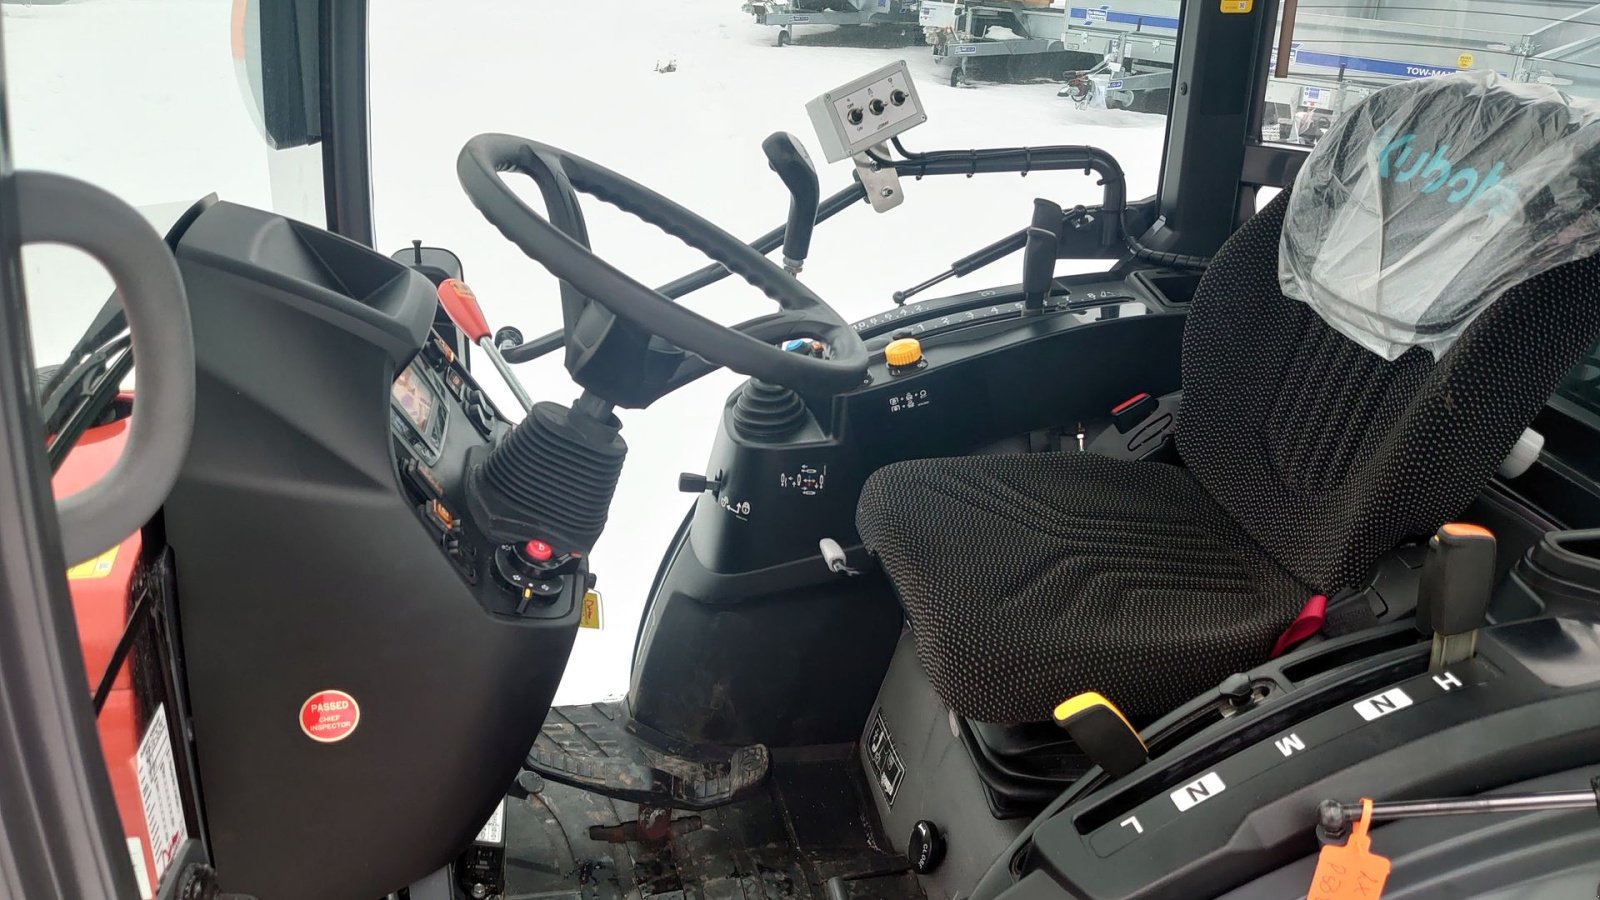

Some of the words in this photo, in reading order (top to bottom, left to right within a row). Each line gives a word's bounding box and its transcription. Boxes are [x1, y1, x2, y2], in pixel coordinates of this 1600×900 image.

[1431, 671, 1464, 691] H
[311, 701, 349, 712] PASSED
[1369, 694, 1397, 714] N
[310, 721, 351, 731] INSPECTOR
[318, 714, 340, 722] CHIEF
[1185, 780, 1211, 803] N
[1119, 815, 1144, 834] L
